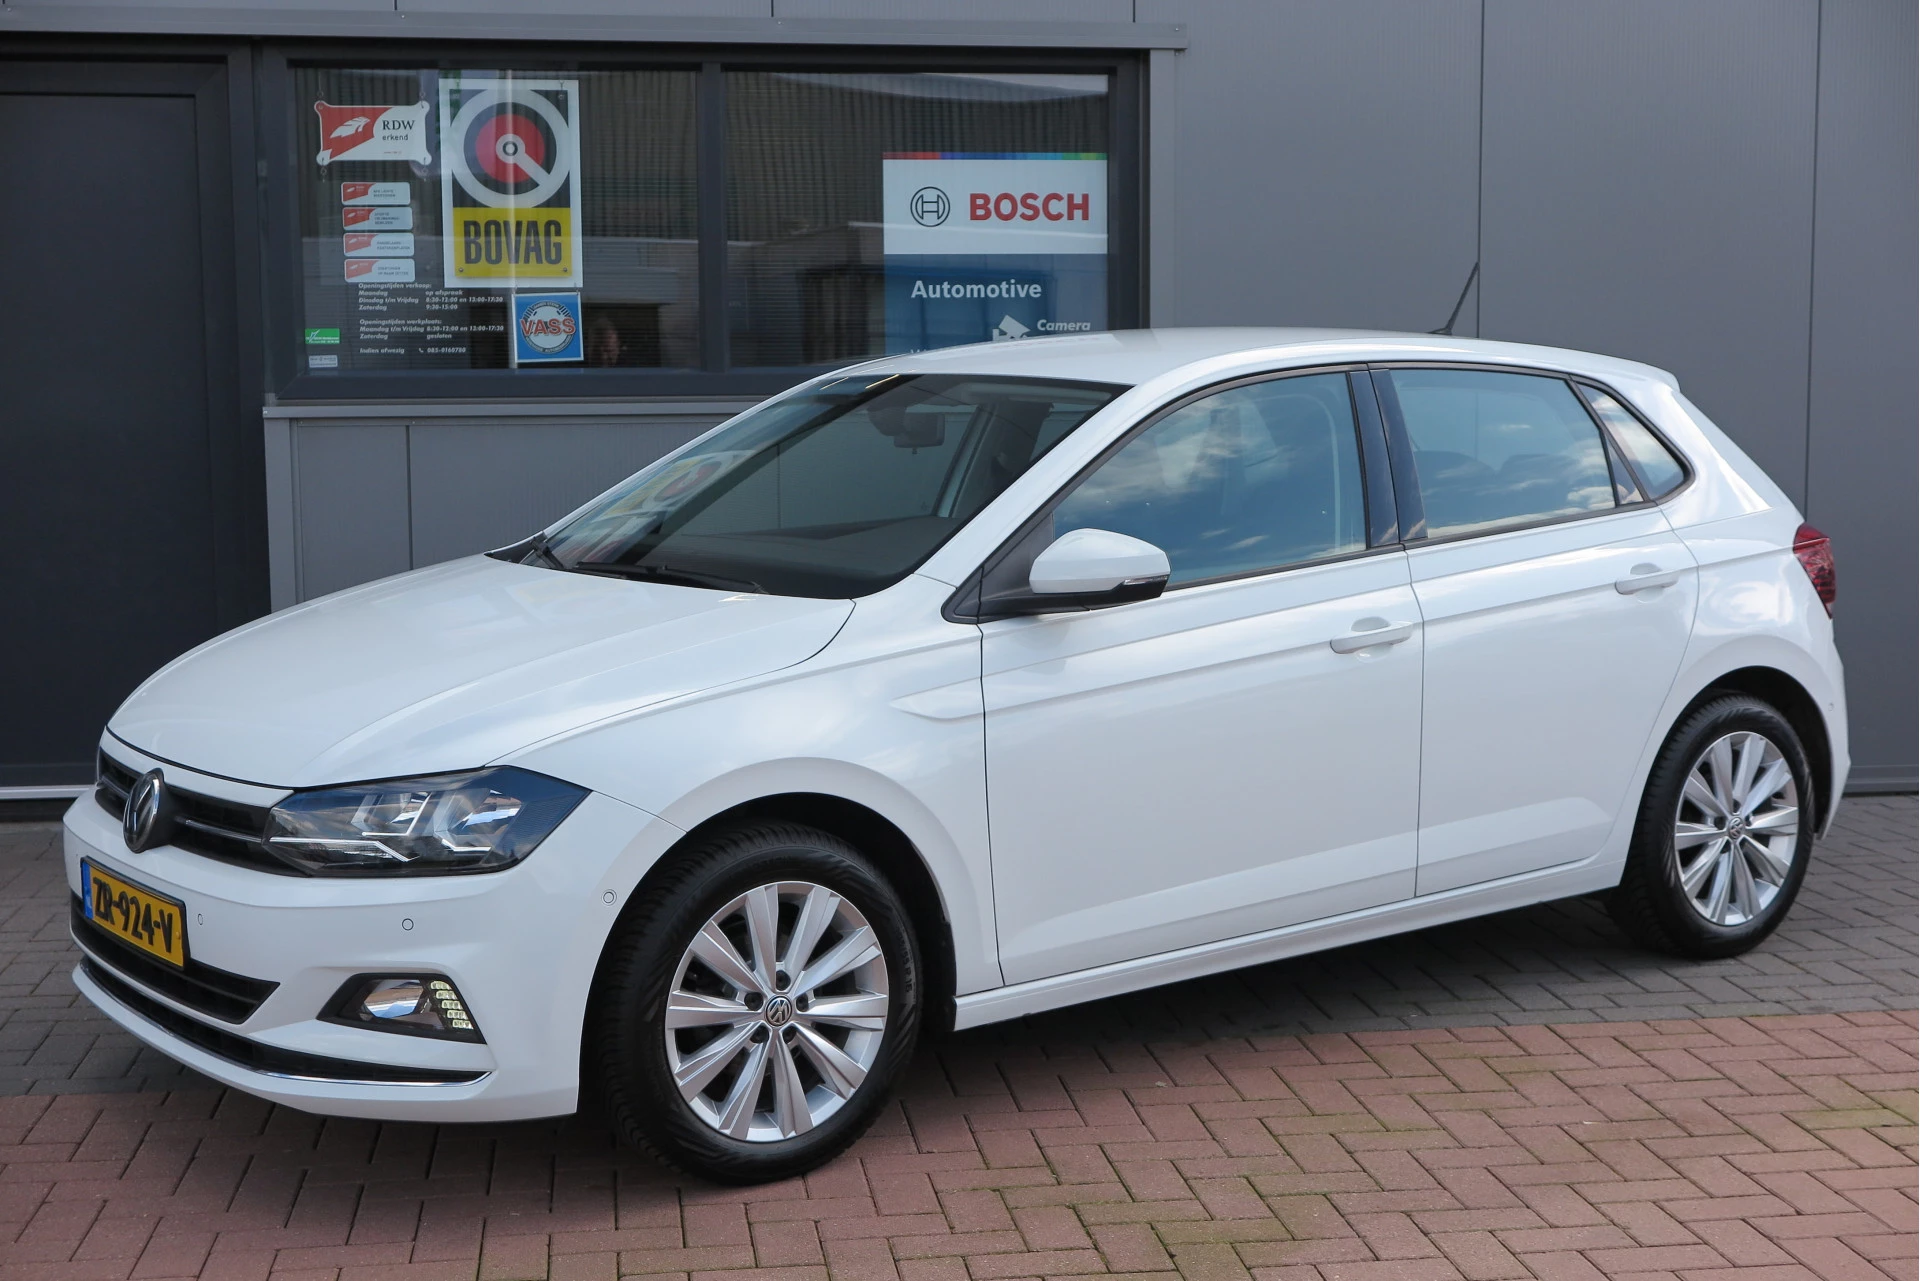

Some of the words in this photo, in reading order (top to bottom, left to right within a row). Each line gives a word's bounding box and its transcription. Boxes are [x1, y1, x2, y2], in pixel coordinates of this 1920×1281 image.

[381, 119, 415, 130] RDW
[381, 133, 409, 141] erkend
[969, 192, 1090, 222] BOSCH
[463, 219, 563, 265] BOVAG
[358, 282, 404, 290] Openingstijden
[405, 282, 432, 290] verkoop:
[910, 278, 1042, 299] Automotive
[359, 318, 406, 326] Openingstijden
[406, 318, 443, 326] werkplaats:
[520, 316, 577, 338] VASS
[1036, 318, 1092, 332] Camera
[92, 876, 173, 954] ZR-924-V
